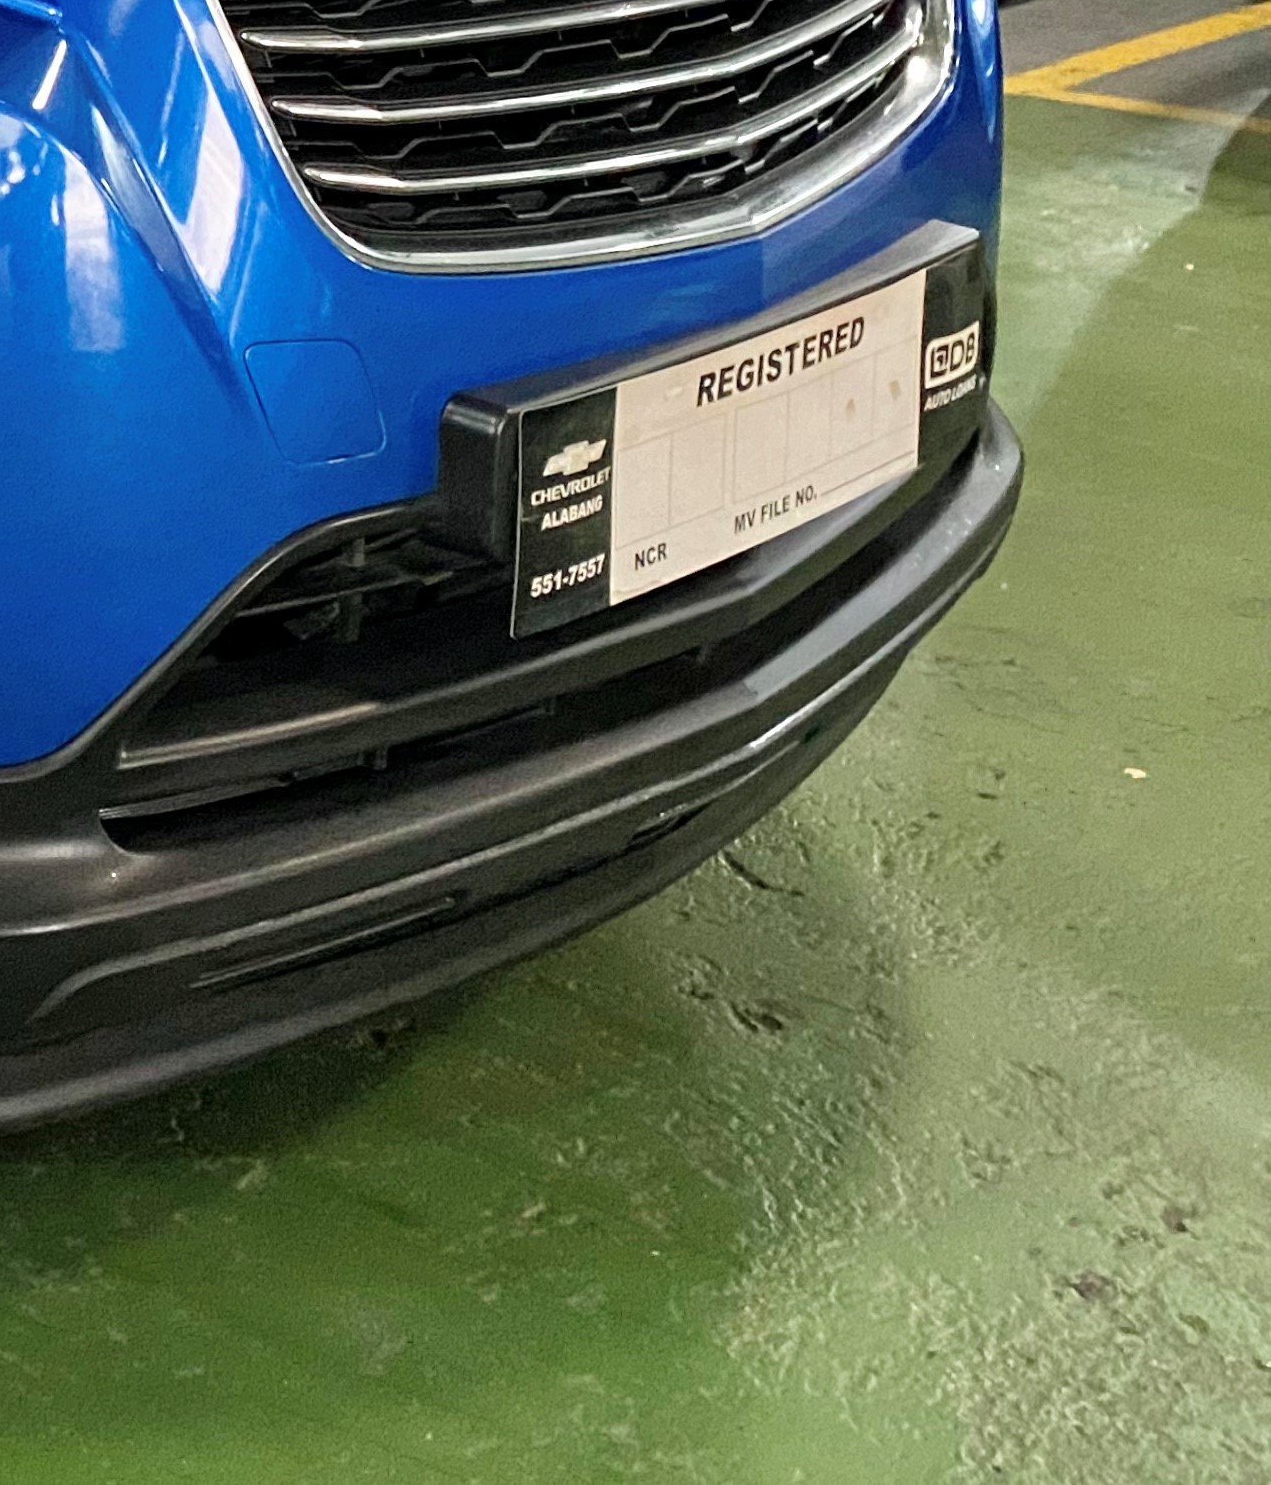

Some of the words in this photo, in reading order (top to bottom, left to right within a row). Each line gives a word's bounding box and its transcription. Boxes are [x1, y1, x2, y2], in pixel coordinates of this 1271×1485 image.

[696, 316, 865, 408] REGISTERED
[530, 466, 612, 506] CHEVROLET
[541, 494, 603, 531] ALABANG
[734, 508, 758, 535] MV
[760, 494, 791, 525] FILE
[795, 484, 818, 509] NO.
[530, 552, 606, 599] 551-7557
[634, 542, 668, 571] NCR
